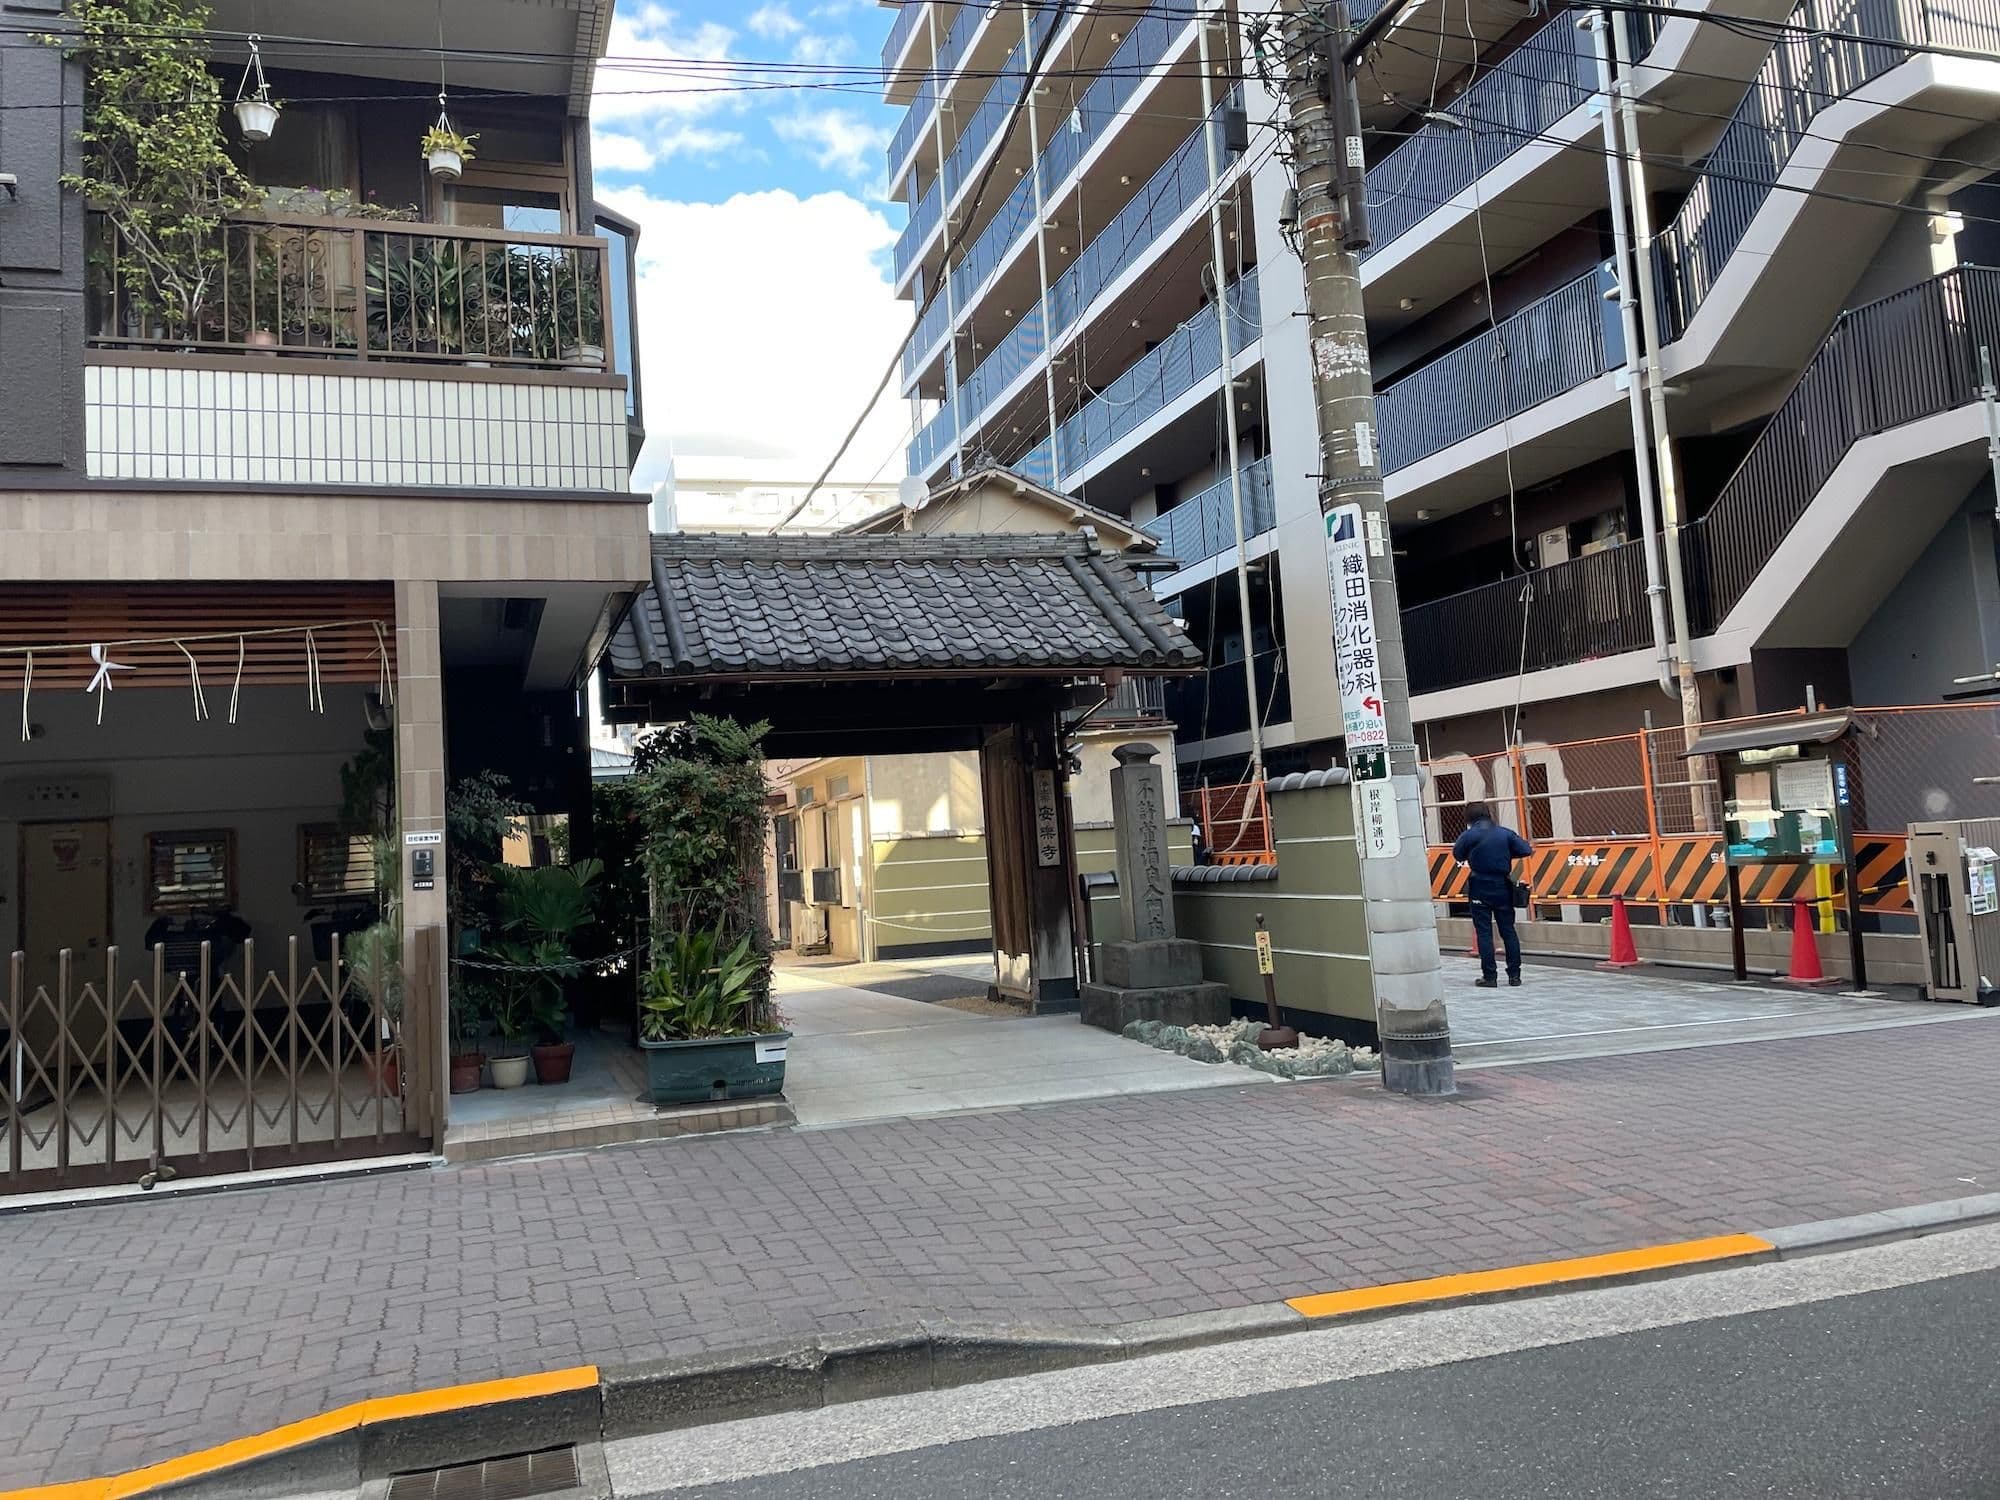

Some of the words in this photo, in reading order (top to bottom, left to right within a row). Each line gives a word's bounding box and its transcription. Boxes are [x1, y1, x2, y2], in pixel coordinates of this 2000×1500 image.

[1338, 606, 1355, 697] クリニック
[1342, 553, 1378, 694] 織田消化器科
